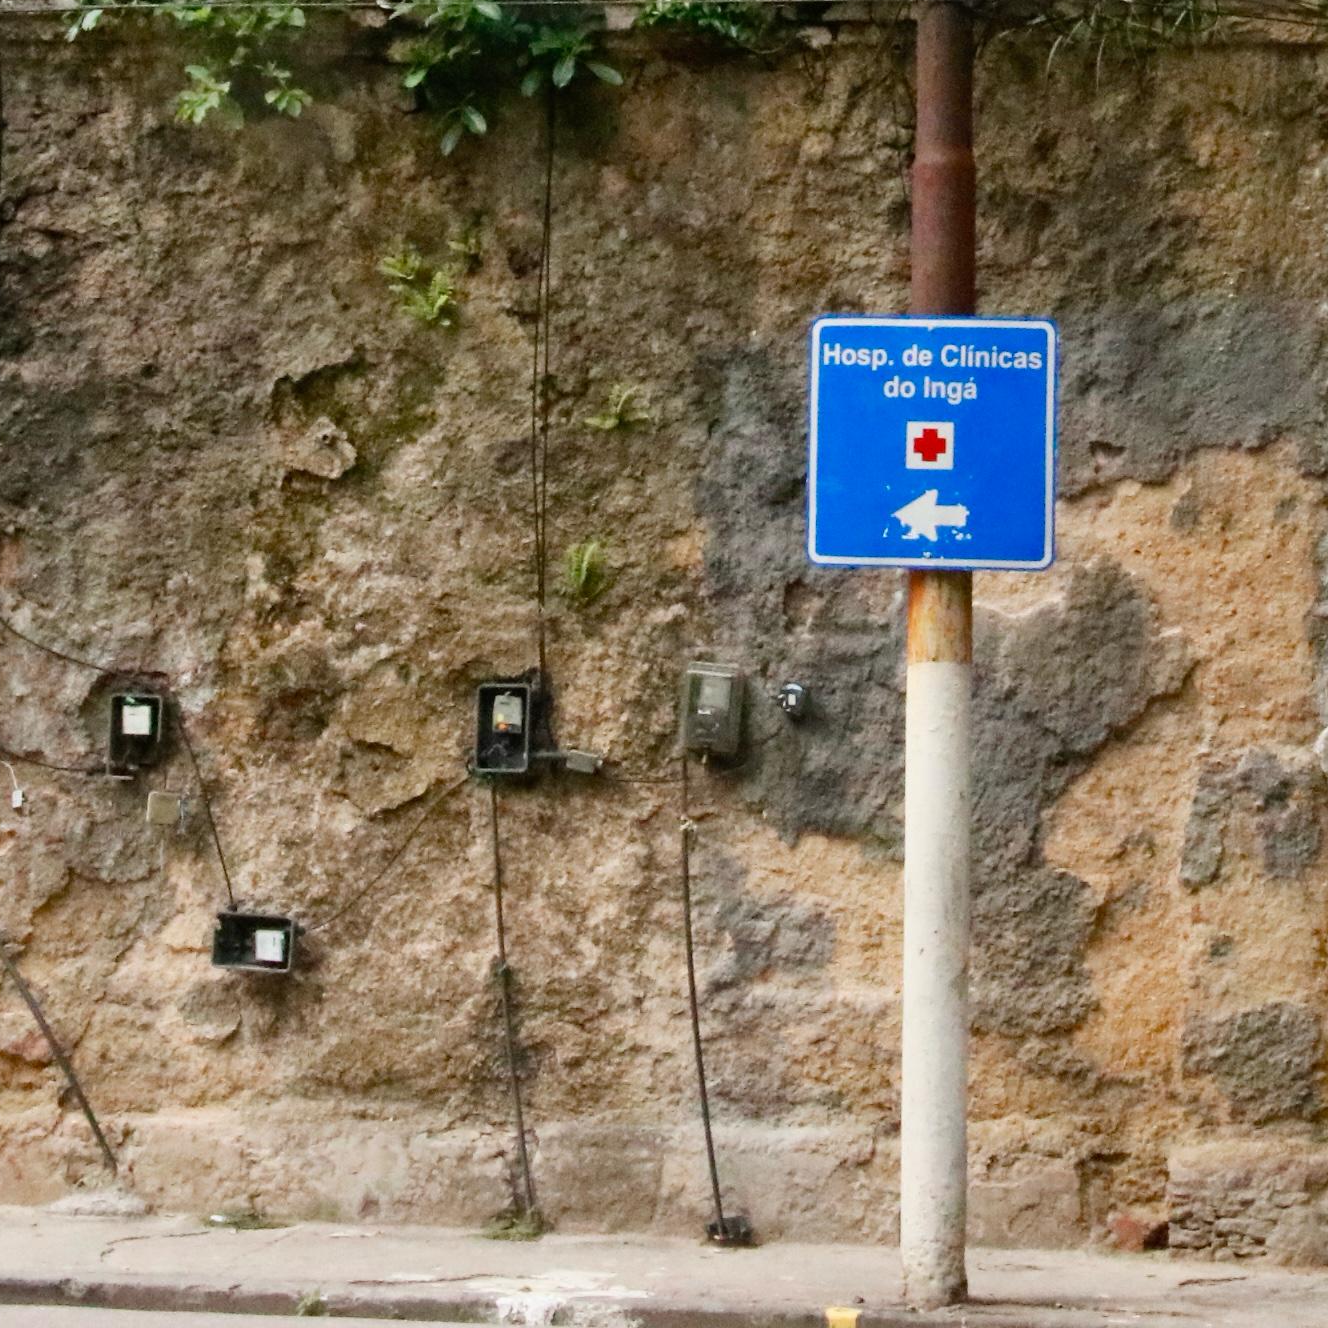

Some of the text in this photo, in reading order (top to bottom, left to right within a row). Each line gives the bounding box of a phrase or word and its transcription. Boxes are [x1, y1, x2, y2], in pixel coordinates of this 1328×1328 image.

[823, 343, 1043, 371] Hosp. de Clínicas
[883, 376, 978, 405] do Ingá
